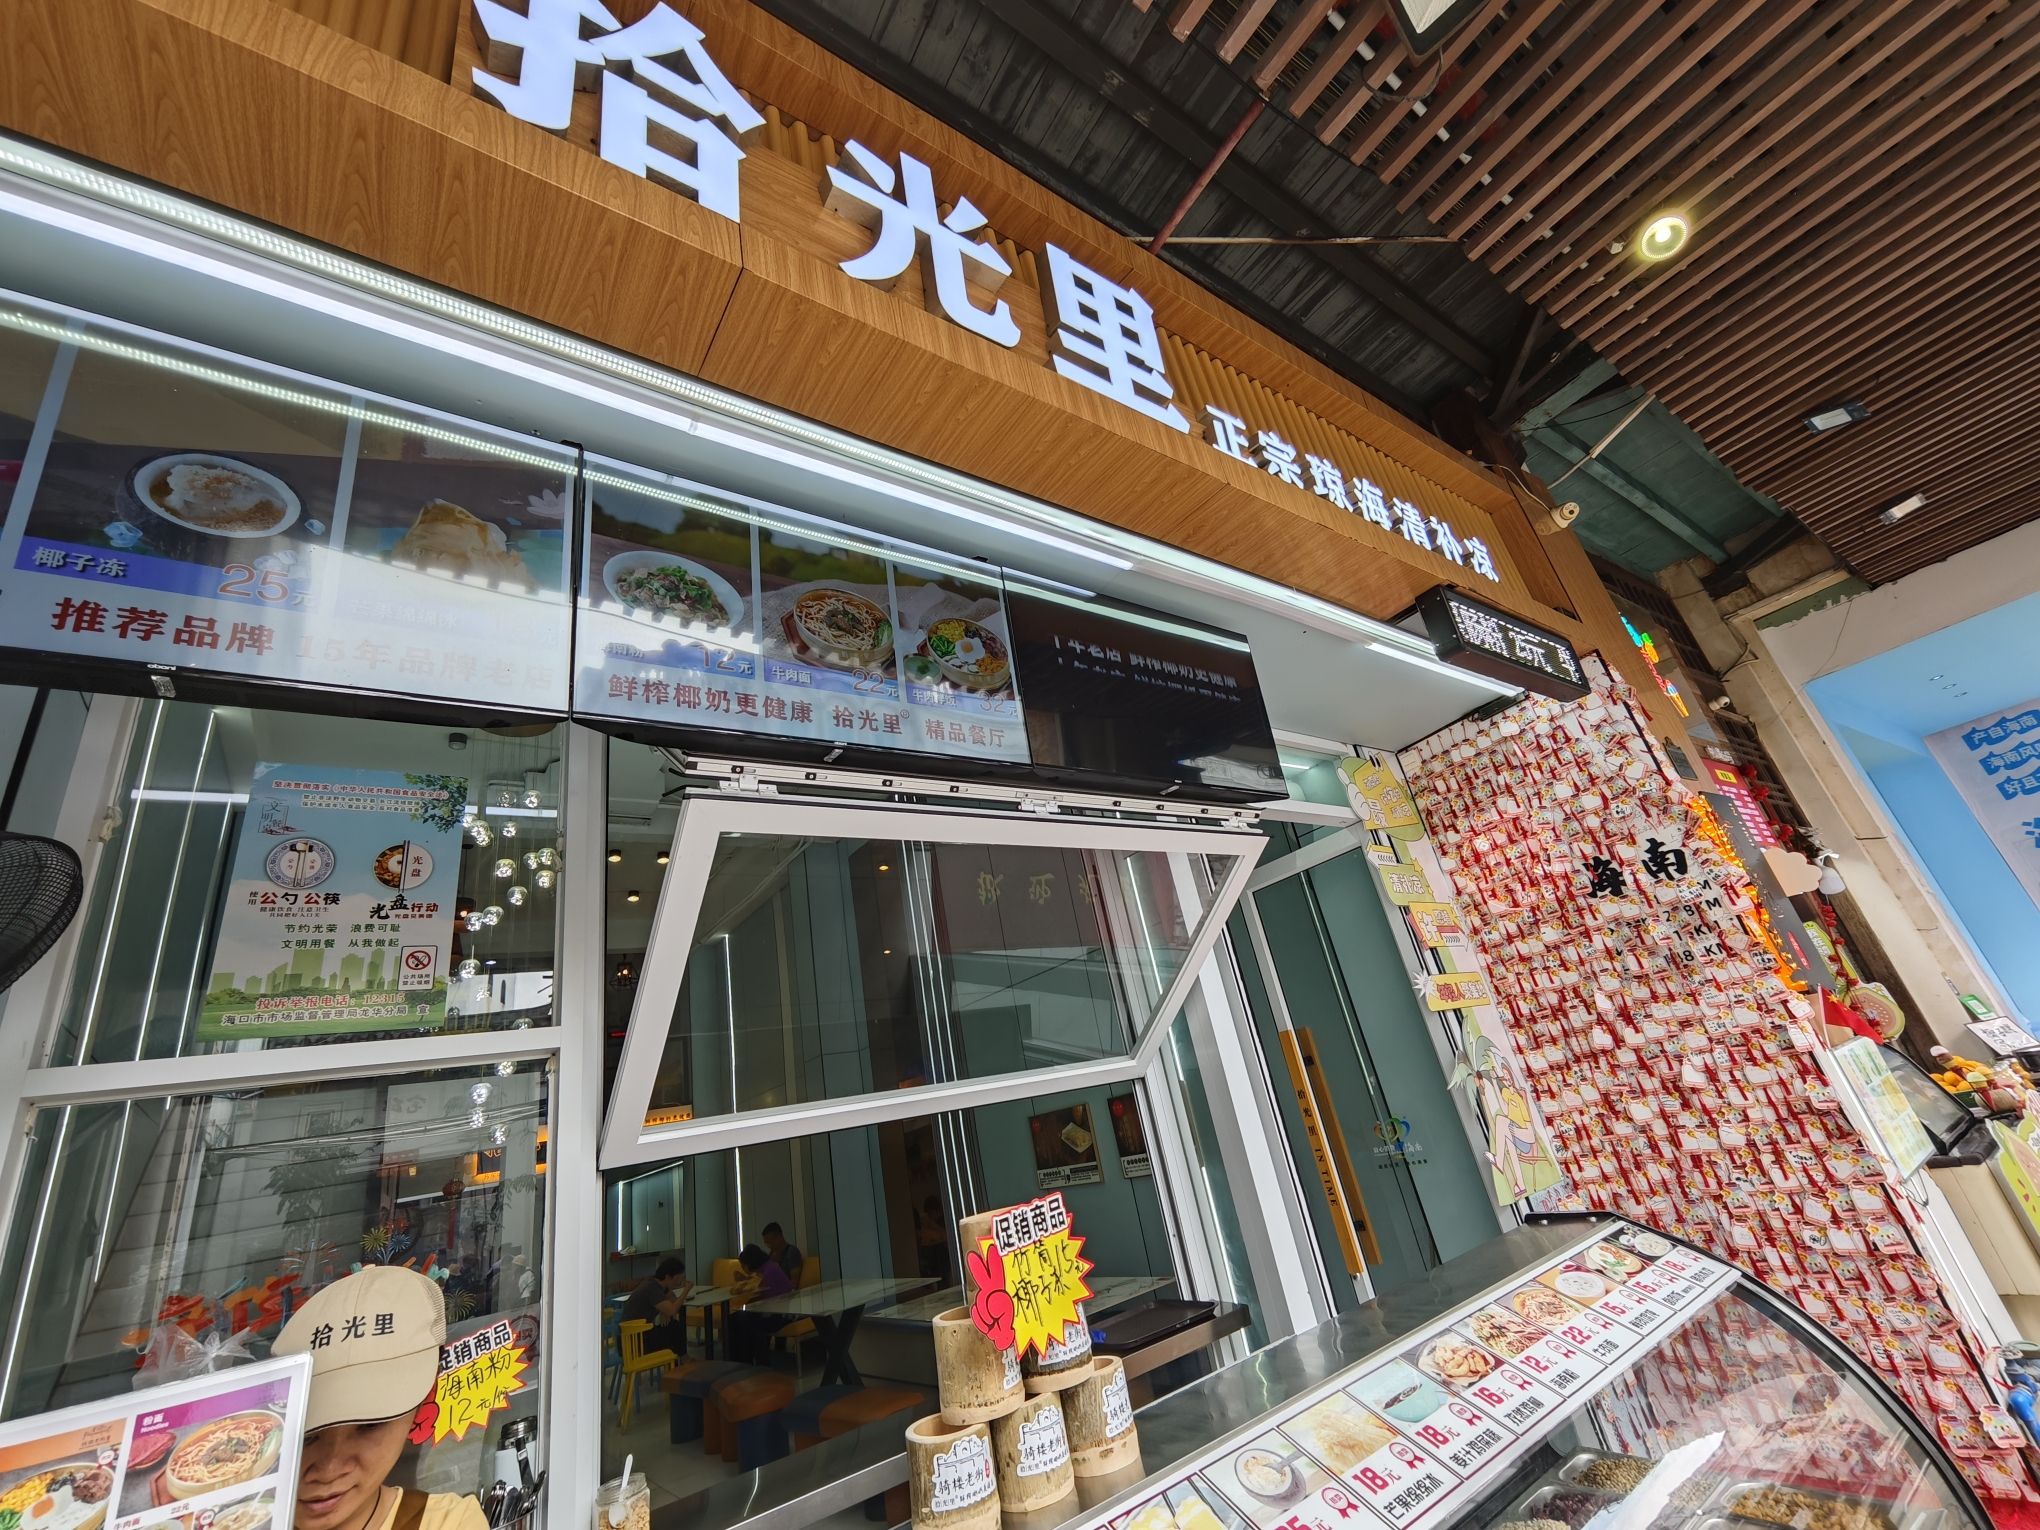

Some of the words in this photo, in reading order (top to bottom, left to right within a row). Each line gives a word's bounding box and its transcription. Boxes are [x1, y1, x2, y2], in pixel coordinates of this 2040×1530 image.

[472, 0, 1190, 434] 拾光里
[1205, 404, 1500, 583] 正宗琼海清补凉
[32, 546, 128, 579] 椰子冻
[50, 595, 274, 657] 推荐品牌
[771, 665, 812, 686] 牛肉面
[851, 667, 899, 698] 22元
[607, 674, 814, 724] 鲜榨椰奶更健康
[925, 718, 1006, 748] 精品餐厅
[281, 939, 336, 949] 文明用餐
[348, 938, 400, 948] 从我做起
[284, 923, 338, 934] 节约光荣
[350, 923, 402, 933] 浪费可耻
[1314, 1148, 1325, 1163] IN
[1321, 1169, 1339, 1207] TIME
[996, 1197, 1066, 1252] 促销商品
[310, 1313, 395, 1350] 拾光里
[439, 1322, 511, 1371] 促销商品
[1561, 1325, 1599, 1345] 22元
[440, 1346, 511, 1401] 海南粉
[1519, 1354, 1558, 1374] 12元
[1549, 1368, 1581, 1390] 海南粉
[1472, 1386, 1514, 1408] 16元
[1415, 1424, 1461, 1449] 18元
[1352, 1466, 1402, 1496] 18元
[1383, 1472, 1444, 1520] 芒果绵绵冰
